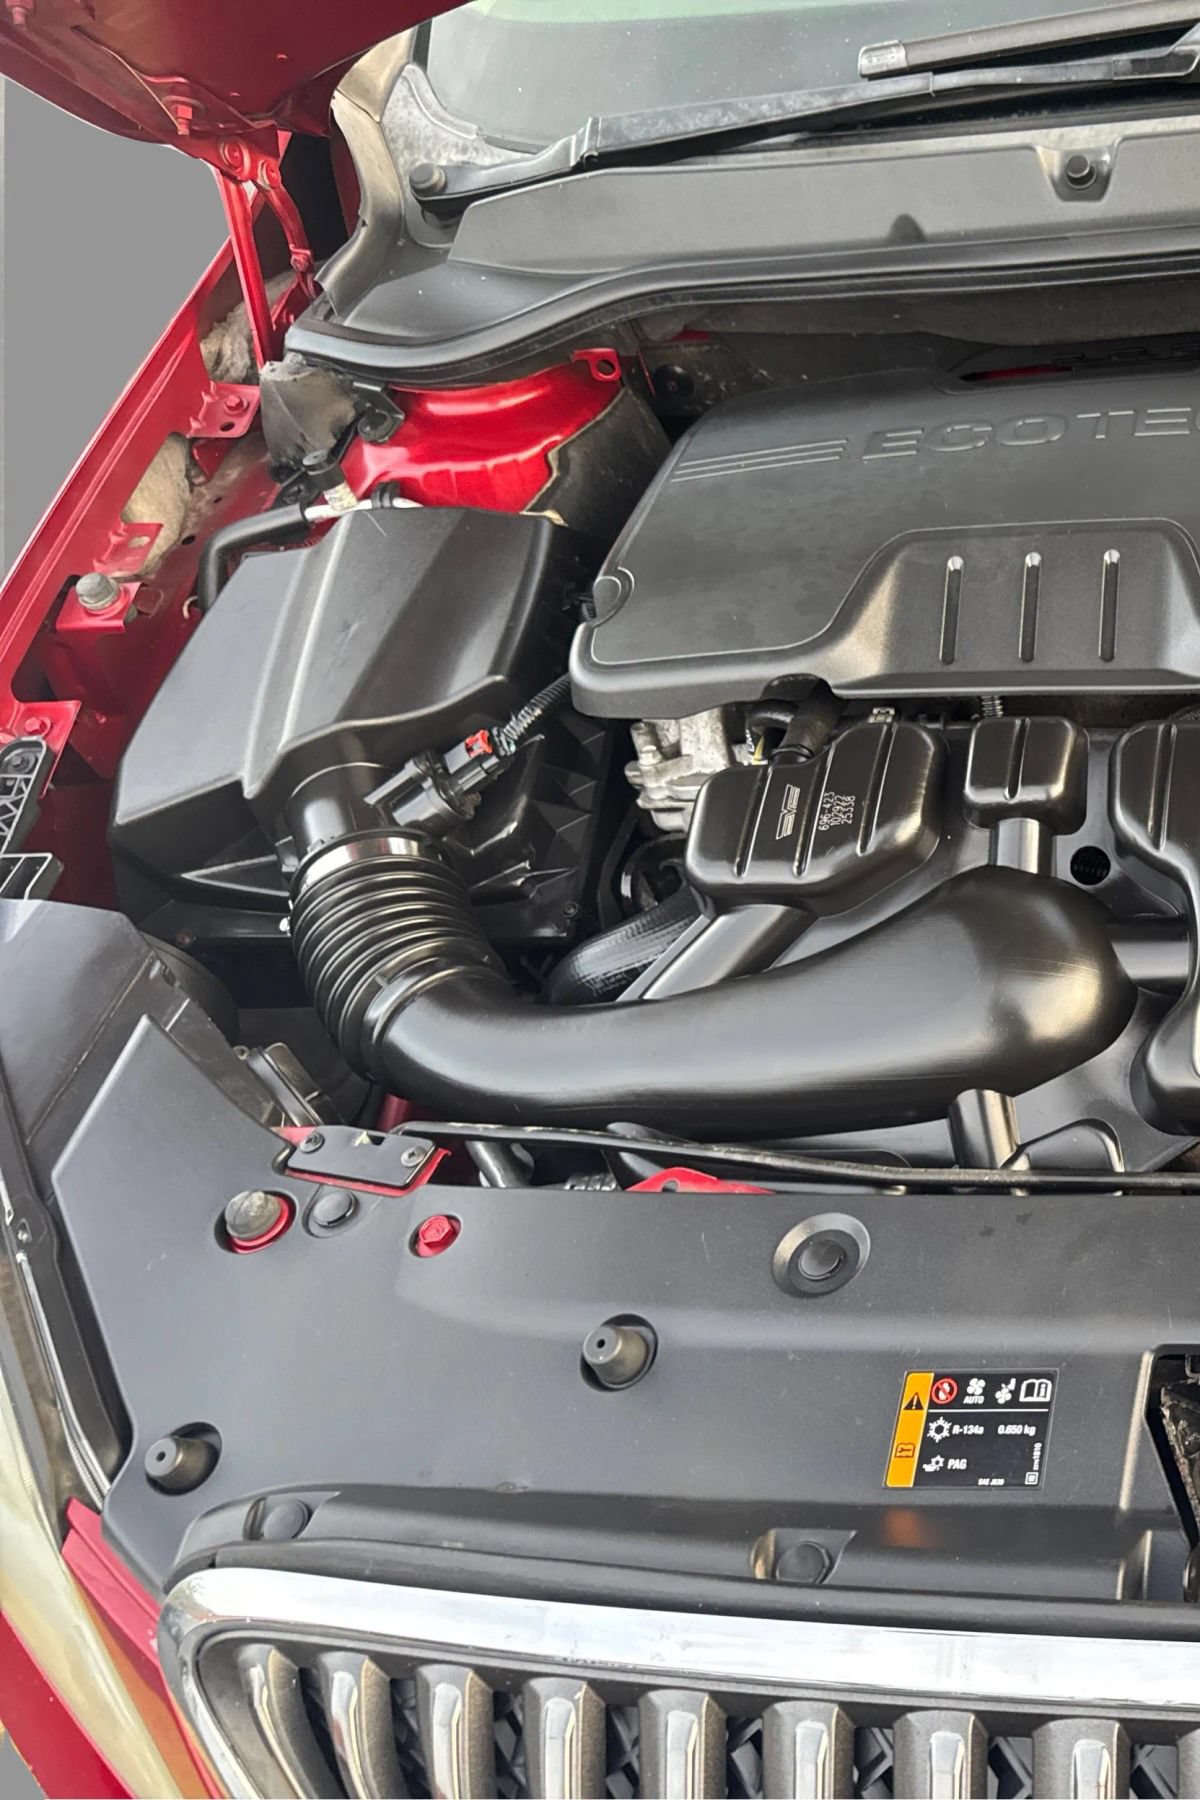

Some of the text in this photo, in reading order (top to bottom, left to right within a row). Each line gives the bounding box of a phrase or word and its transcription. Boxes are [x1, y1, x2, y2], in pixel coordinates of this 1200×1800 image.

[818, 791, 836, 831] 696-423
[830, 794, 845, 826] 102922
[841, 795, 856, 825] 25338
[963, 1395, 984, 1404] AUTO
[952, 1424, 1036, 1437] R-134a 0.650 kg
[947, 1458, 968, 1470] PAG
